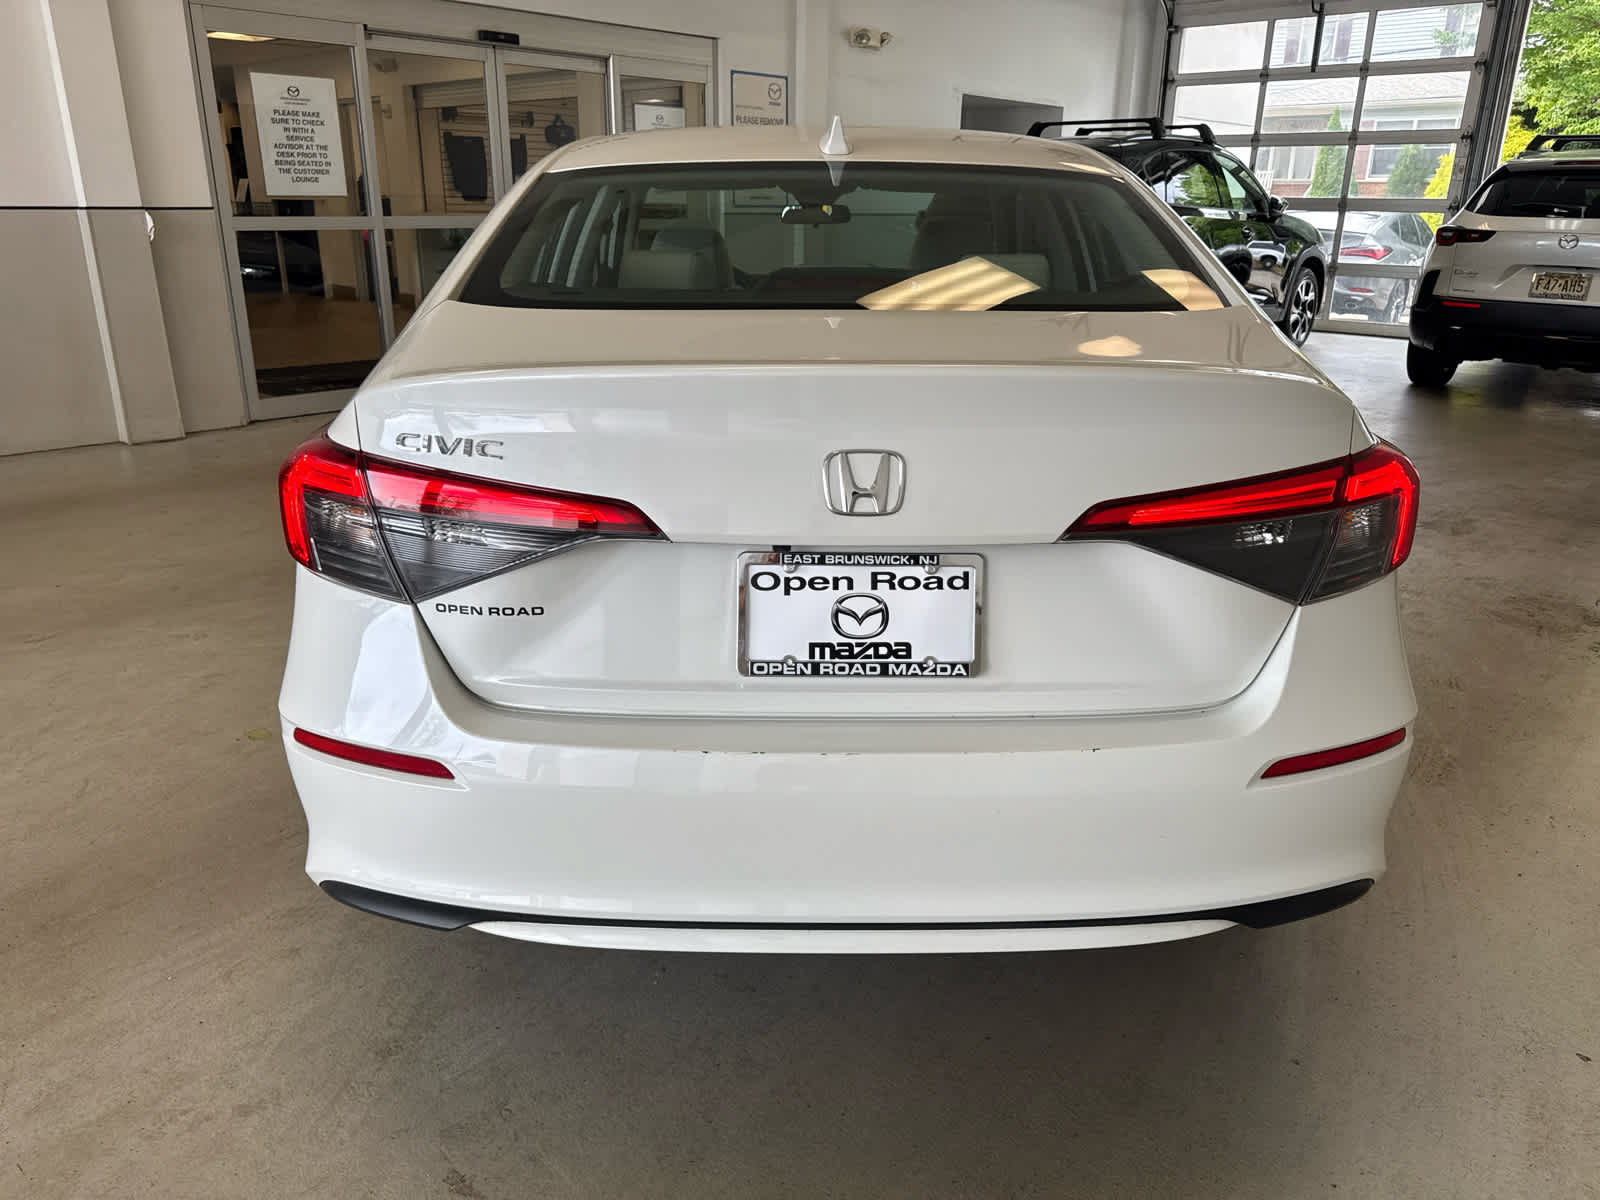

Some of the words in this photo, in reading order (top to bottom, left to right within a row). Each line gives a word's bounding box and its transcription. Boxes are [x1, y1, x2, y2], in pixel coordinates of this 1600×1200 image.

[273, 109, 299, 117] PLEASE
[736, 114, 759, 125] PLEASE
[396, 432, 504, 460] CIVIC
[783, 554, 820, 564] EAST
[825, 554, 914, 565] BRUNSWICK,
[919, 555, 938, 565] NJ
[751, 571, 854, 596] Open
[871, 571, 970, 591] Road
[436, 603, 483, 616] OPEN
[488, 606, 544, 616] ROAD
[752, 663, 812, 674] OPEN
[819, 663, 881, 675] ROAD
[888, 663, 968, 675] MAZDA
